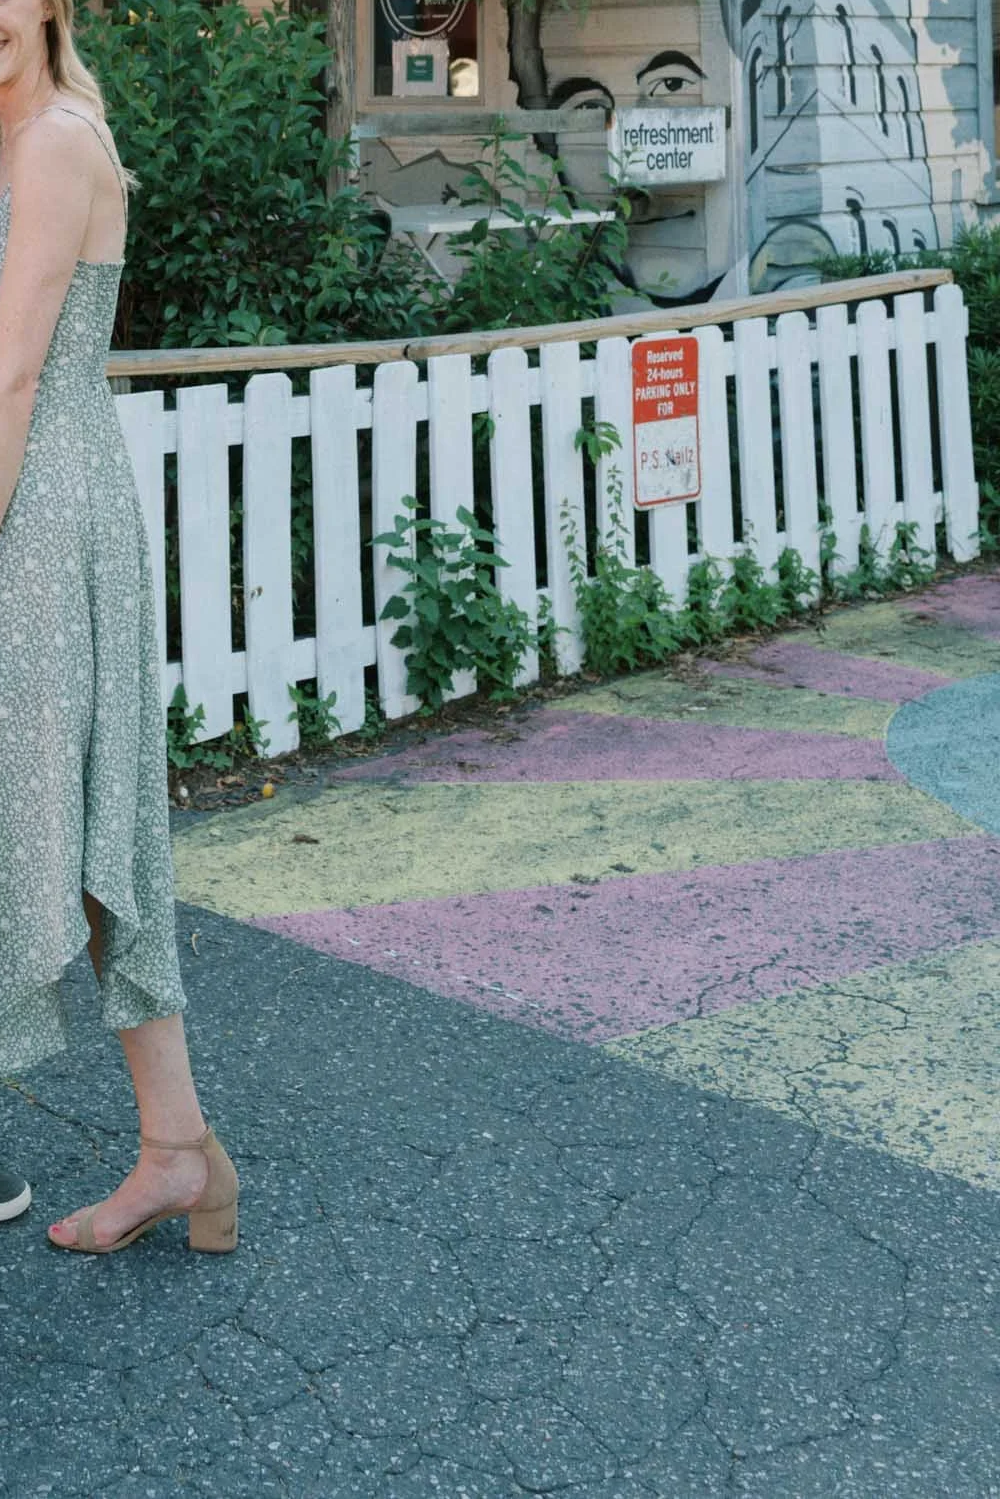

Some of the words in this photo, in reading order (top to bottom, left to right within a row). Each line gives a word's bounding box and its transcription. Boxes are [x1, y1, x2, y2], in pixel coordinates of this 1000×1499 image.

[624, 121, 713, 146] refreshment
[646, 147, 693, 170] center
[646, 347, 684, 363] Reserved
[647, 367, 684, 382] 24-hours
[635, 384, 671, 401] PARKING
[673, 381, 696, 397] ONLY
[657, 401, 674, 416] FOR
